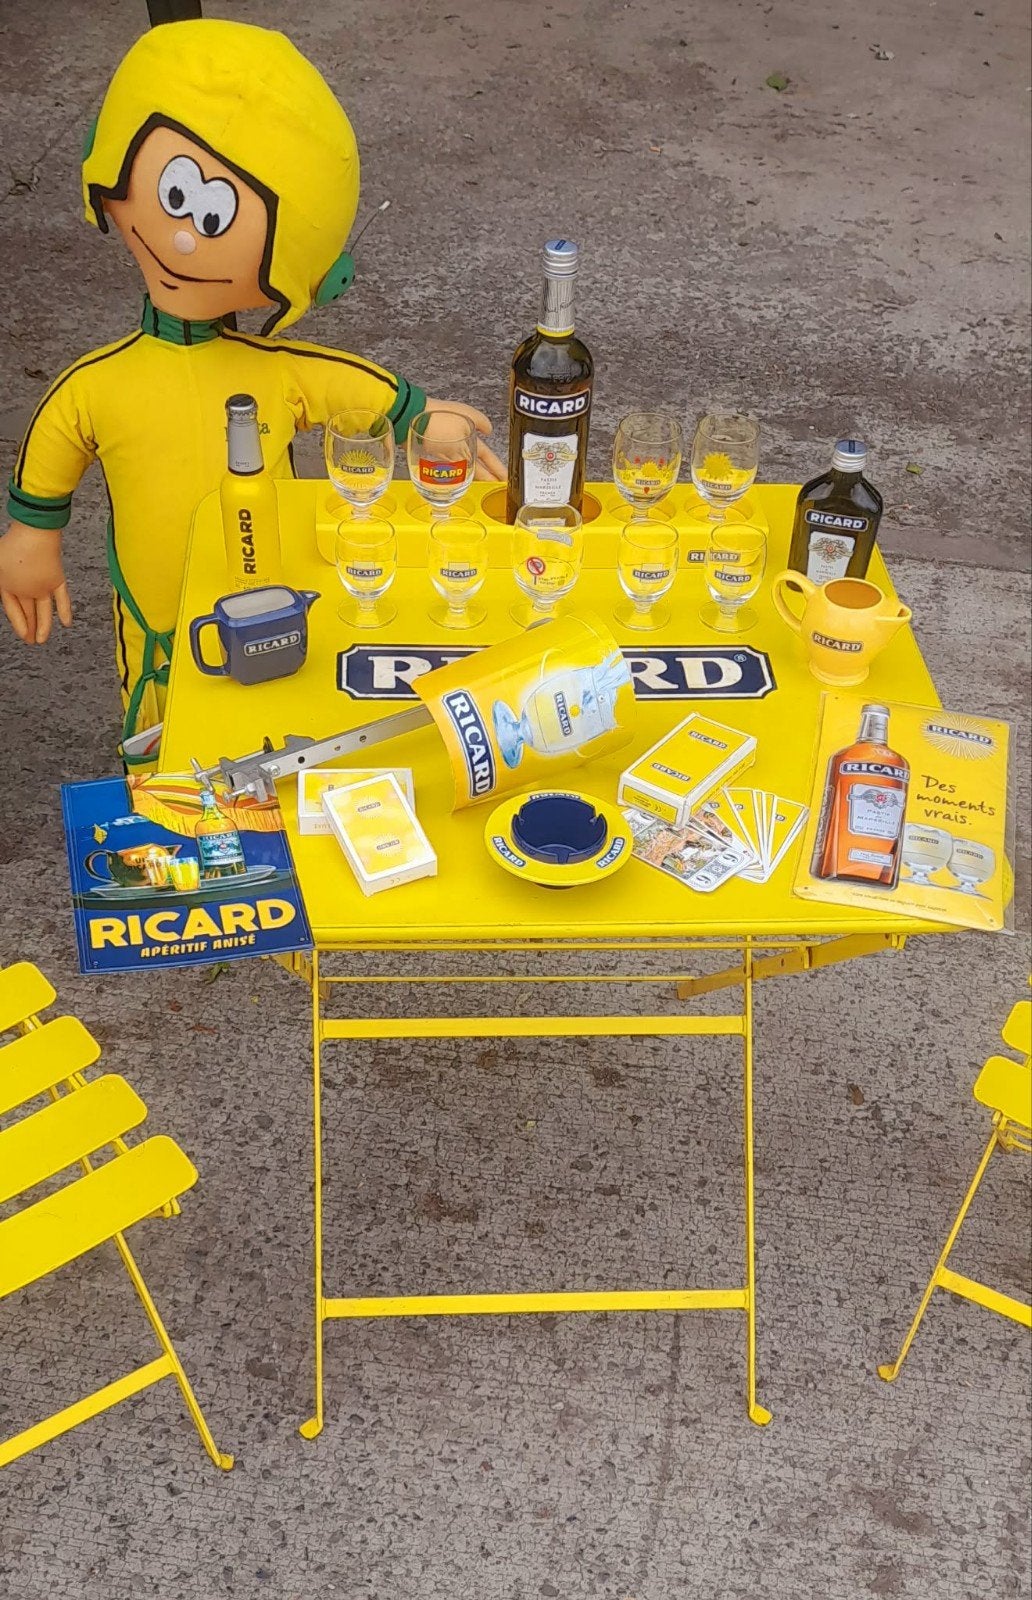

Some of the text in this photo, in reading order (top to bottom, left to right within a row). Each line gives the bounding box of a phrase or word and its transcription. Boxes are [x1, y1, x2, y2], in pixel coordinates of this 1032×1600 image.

[518, 394, 585, 415] RICARD
[342, 465, 375, 474] RICARD
[422, 467, 463, 479] RICARD
[810, 512, 864, 529] RICARD
[238, 508, 256, 575] RICARD
[442, 568, 476, 577] RICARD
[634, 570, 669, 579] RICARD
[715, 571, 751, 582] RICARD
[247, 634, 298, 654] RICARD
[813, 633, 862, 652] RICARD
[556, 693, 572, 735] RICARD
[449, 694, 492, 794] RICARD
[931, 724, 992, 745] RICARD
[921, 774, 957, 794] Des
[916, 793, 996, 816] moments
[924, 808, 973, 826] vrais.
[493, 836, 524, 867] RICARD
[597, 838, 625, 868] RICARD
[89, 898, 297, 949] RICARD
[140, 933, 256, 958] APÉRITIF ANISÉ
